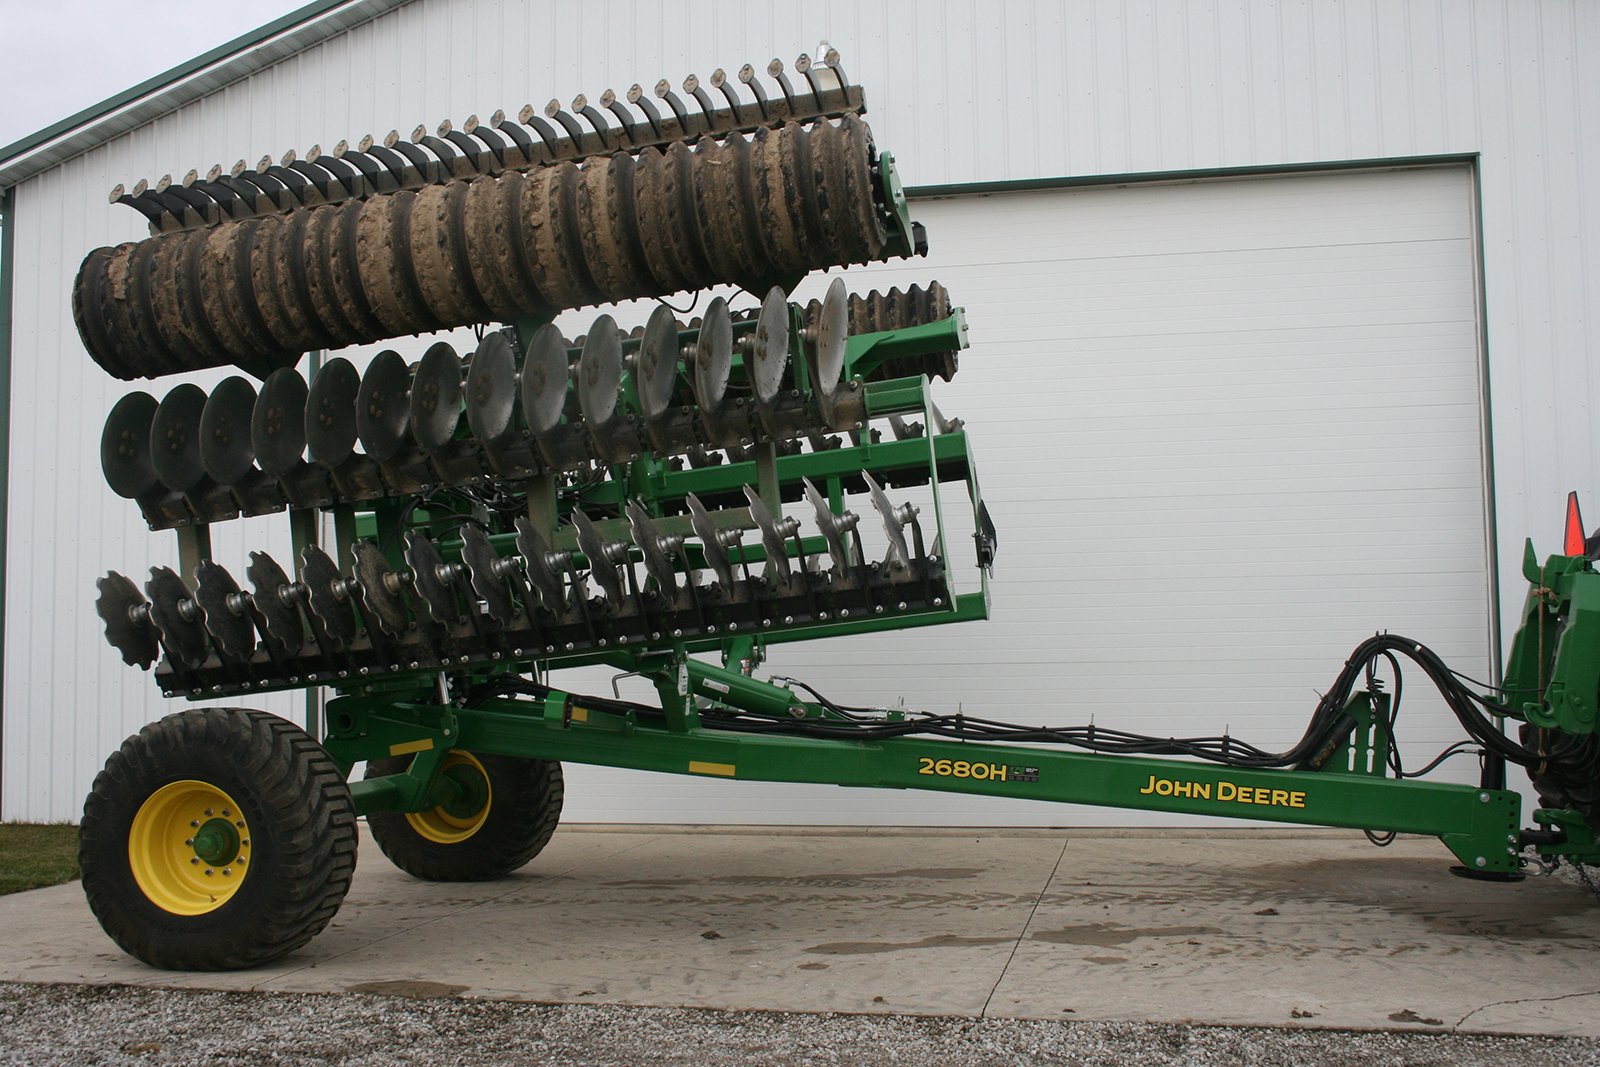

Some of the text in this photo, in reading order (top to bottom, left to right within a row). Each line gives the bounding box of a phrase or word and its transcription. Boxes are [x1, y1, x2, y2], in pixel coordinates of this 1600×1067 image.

[918, 757, 1007, 781] 2680H
[1139, 775, 1306, 808] JOHN DEERE
